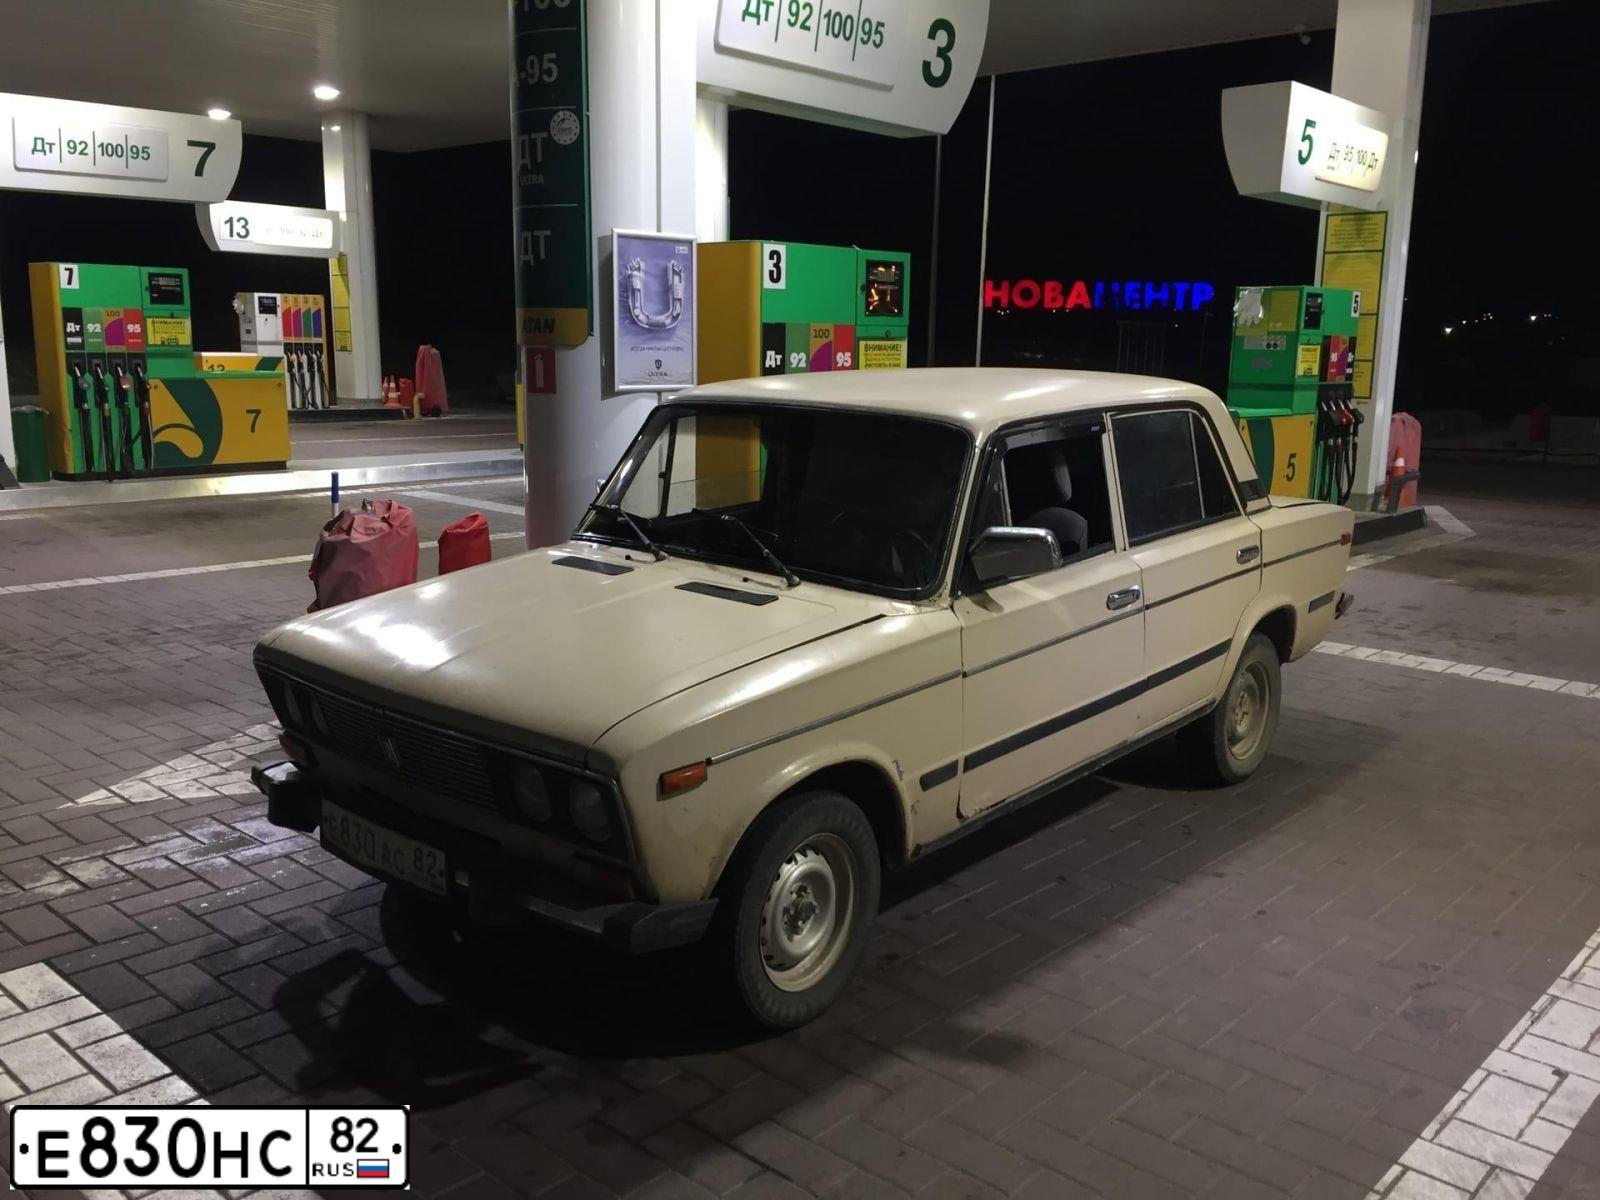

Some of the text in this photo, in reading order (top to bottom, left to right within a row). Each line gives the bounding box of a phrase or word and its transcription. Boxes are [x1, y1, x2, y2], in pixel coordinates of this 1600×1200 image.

[787, 0, 814, 31] 92
[823, 9, 854, 42] 100
[860, 17, 886, 49] 95
[921, 18, 956, 88] 3
[31, 137, 151, 161] Дт 92 100 95
[1298, 118, 1317, 165] 5
[187, 139, 216, 177] 7
[223, 216, 250, 239] 13
[64, 267, 75, 286] 7
[769, 250, 782, 283] 3
[105, 310, 121, 318] 100
[1353, 294, 1360, 314] 5
[66, 322, 81, 334] Дт
[86, 323, 102, 334] 92
[127, 323, 141, 334] 95
[813, 329, 830, 338] 100
[765, 351, 852, 368] Дт 92 95
[246, 409, 261, 433] 7
[1286, 453, 1297, 481] 5
[414, 847, 437, 879] 82
